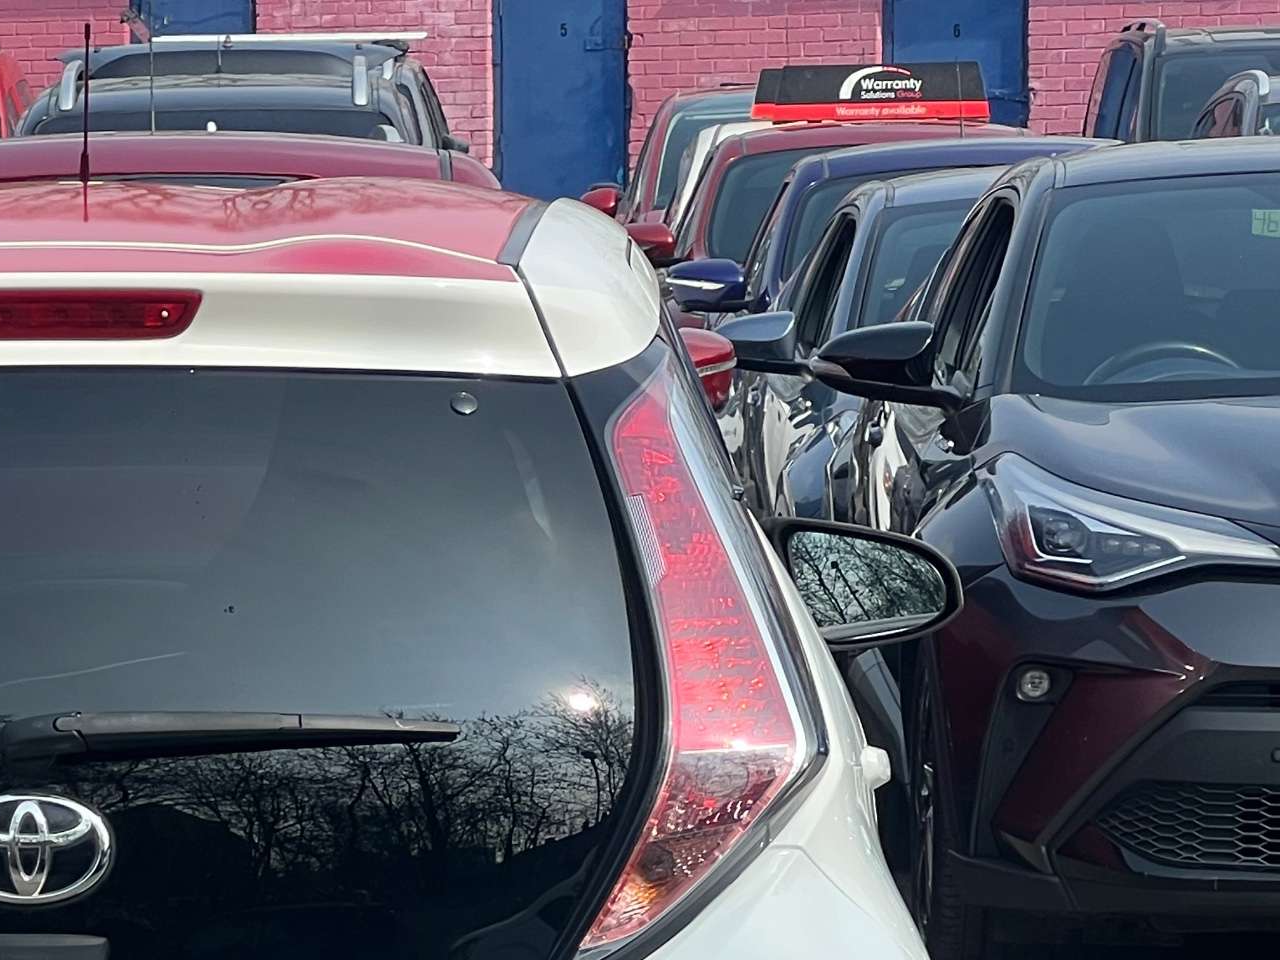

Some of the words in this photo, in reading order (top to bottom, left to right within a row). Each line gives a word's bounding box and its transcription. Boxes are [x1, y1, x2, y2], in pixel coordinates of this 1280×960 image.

[560, 23, 568, 38] 5
[953, 23, 961, 38] 6
[860, 78, 922, 92] Warranty
[860, 91, 895, 99] Solutions
[896, 91, 922, 99] Group
[835, 106, 880, 117] Warranty
[881, 105, 927, 115] available
